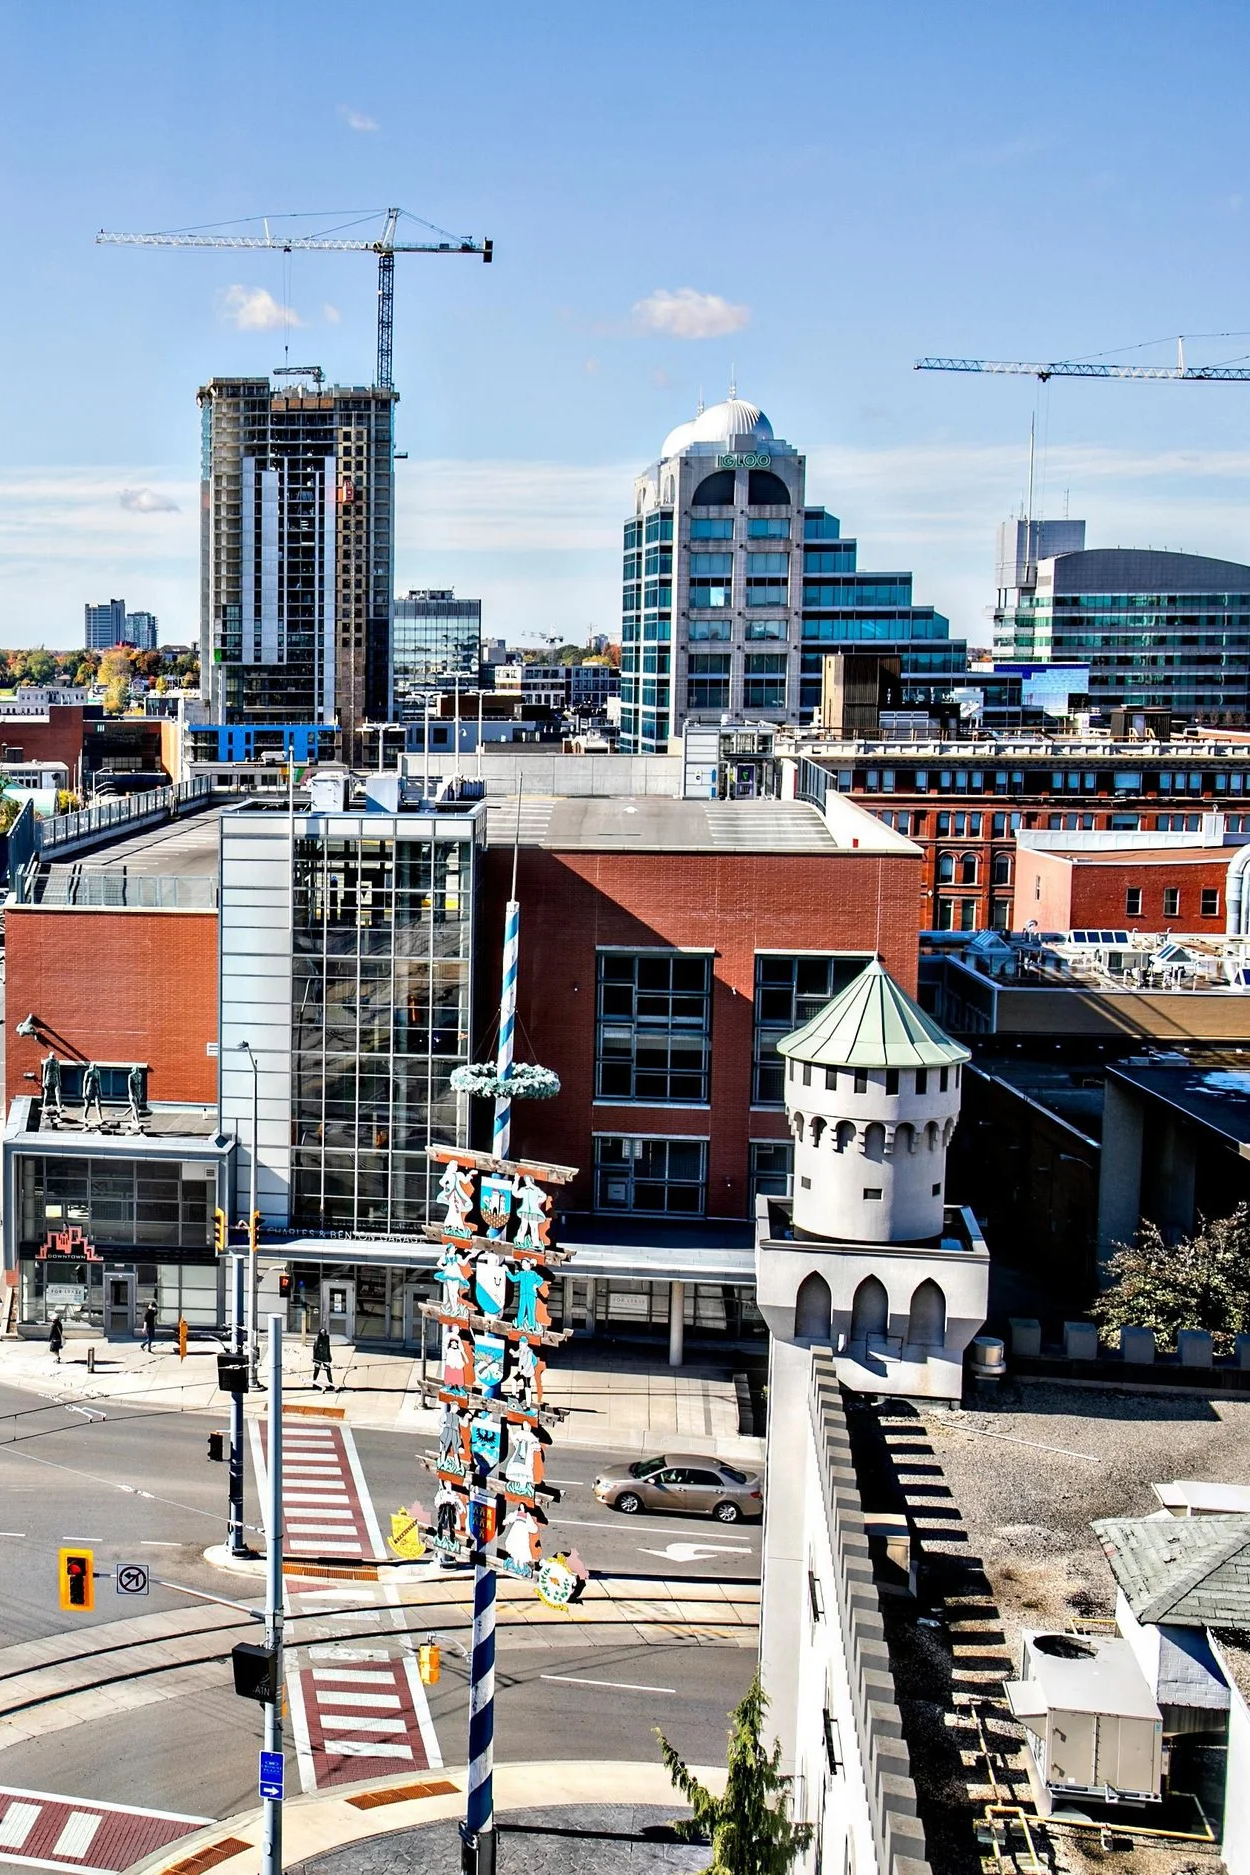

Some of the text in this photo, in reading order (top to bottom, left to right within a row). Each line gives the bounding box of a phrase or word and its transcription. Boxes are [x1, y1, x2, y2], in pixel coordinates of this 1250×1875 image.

[716, 454, 771, 467] IGLOO
[267, 1226, 315, 1238] CHARLES
[319, 1231, 326, 1239] &
[330, 1231, 376, 1242] BENTON
